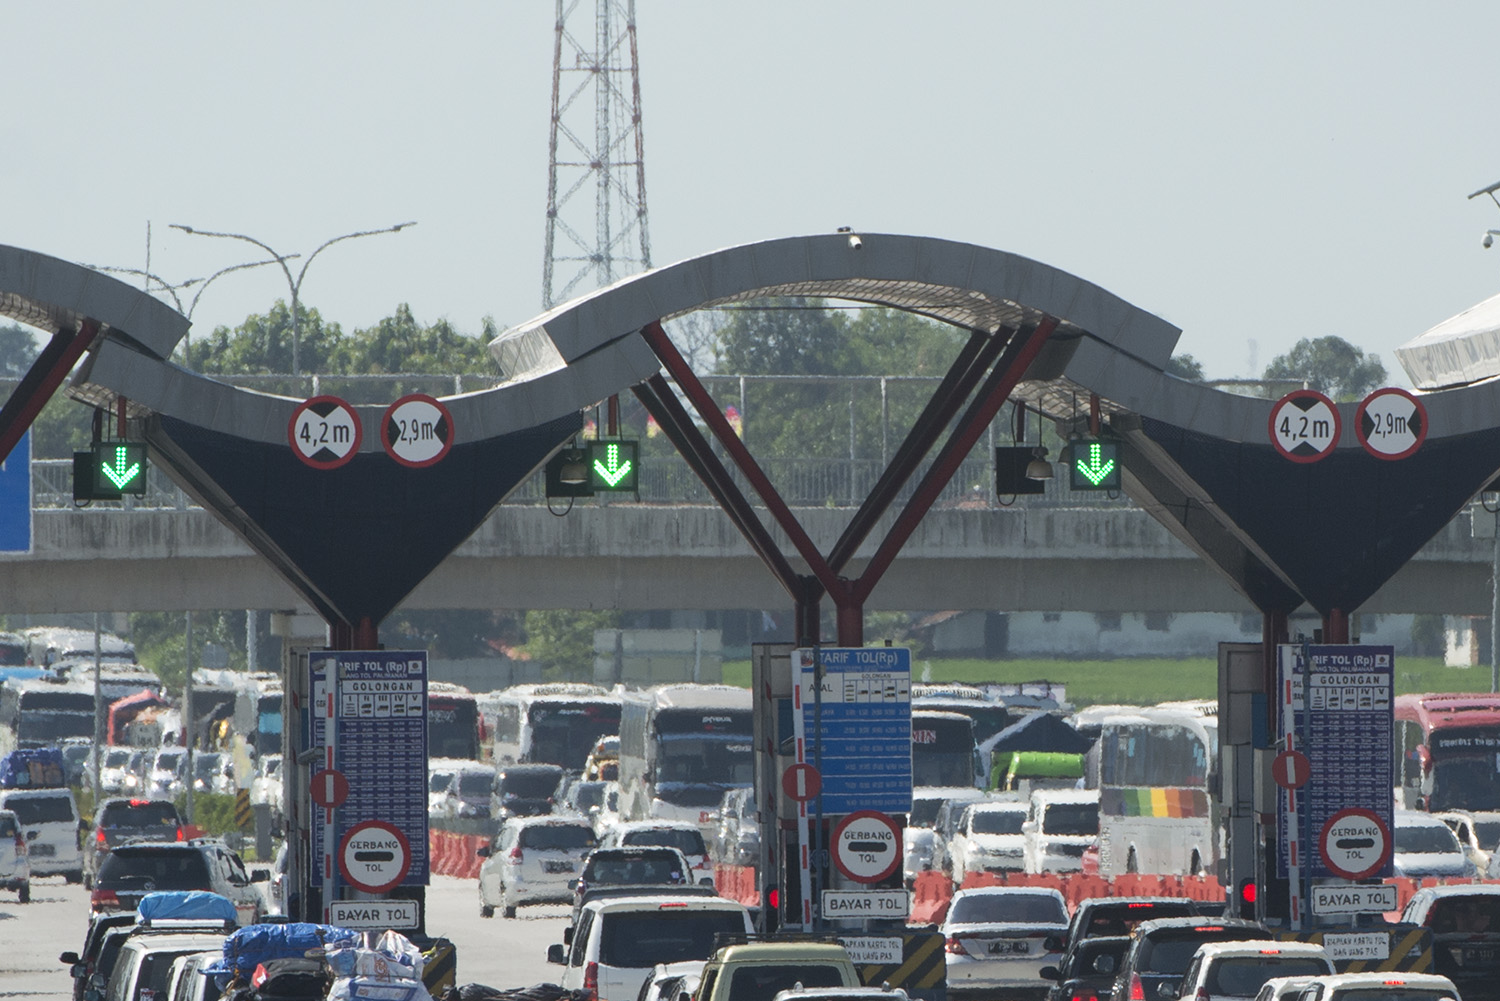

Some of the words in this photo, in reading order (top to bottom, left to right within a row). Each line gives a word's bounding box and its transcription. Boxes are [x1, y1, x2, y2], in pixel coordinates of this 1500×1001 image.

[1374, 412, 1406, 438] 2,9m
[400, 418, 433, 445] 2,9m
[1298, 656, 1328, 664] TRIF
[1331, 656, 1350, 664] TOL
[1353, 654, 1374, 667] (Rp)
[340, 662, 362, 672] ARIF
[364, 662, 384, 672] TOL
[386, 662, 406, 674] (Rp)
[1320, 676, 1380, 684] GOLONGAN
[352, 682, 413, 692] GOLONGAN
[809, 684, 833, 692] AAL
[844, 832, 892, 840] GERBANG
[1331, 828, 1379, 836] GERBANG
[350, 840, 398, 849] GERBANG
[858, 854, 877, 863] TOL
[1345, 851, 1365, 859] TOL
[365, 864, 384, 872] TOL
[830, 898, 872, 910] BAYAR
[878, 898, 902, 910] TOL
[1319, 894, 1360, 906] BAYAR
[1367, 893, 1390, 904] TOL
[338, 910, 380, 921] BAYAR
[388, 908, 410, 920] TOL
